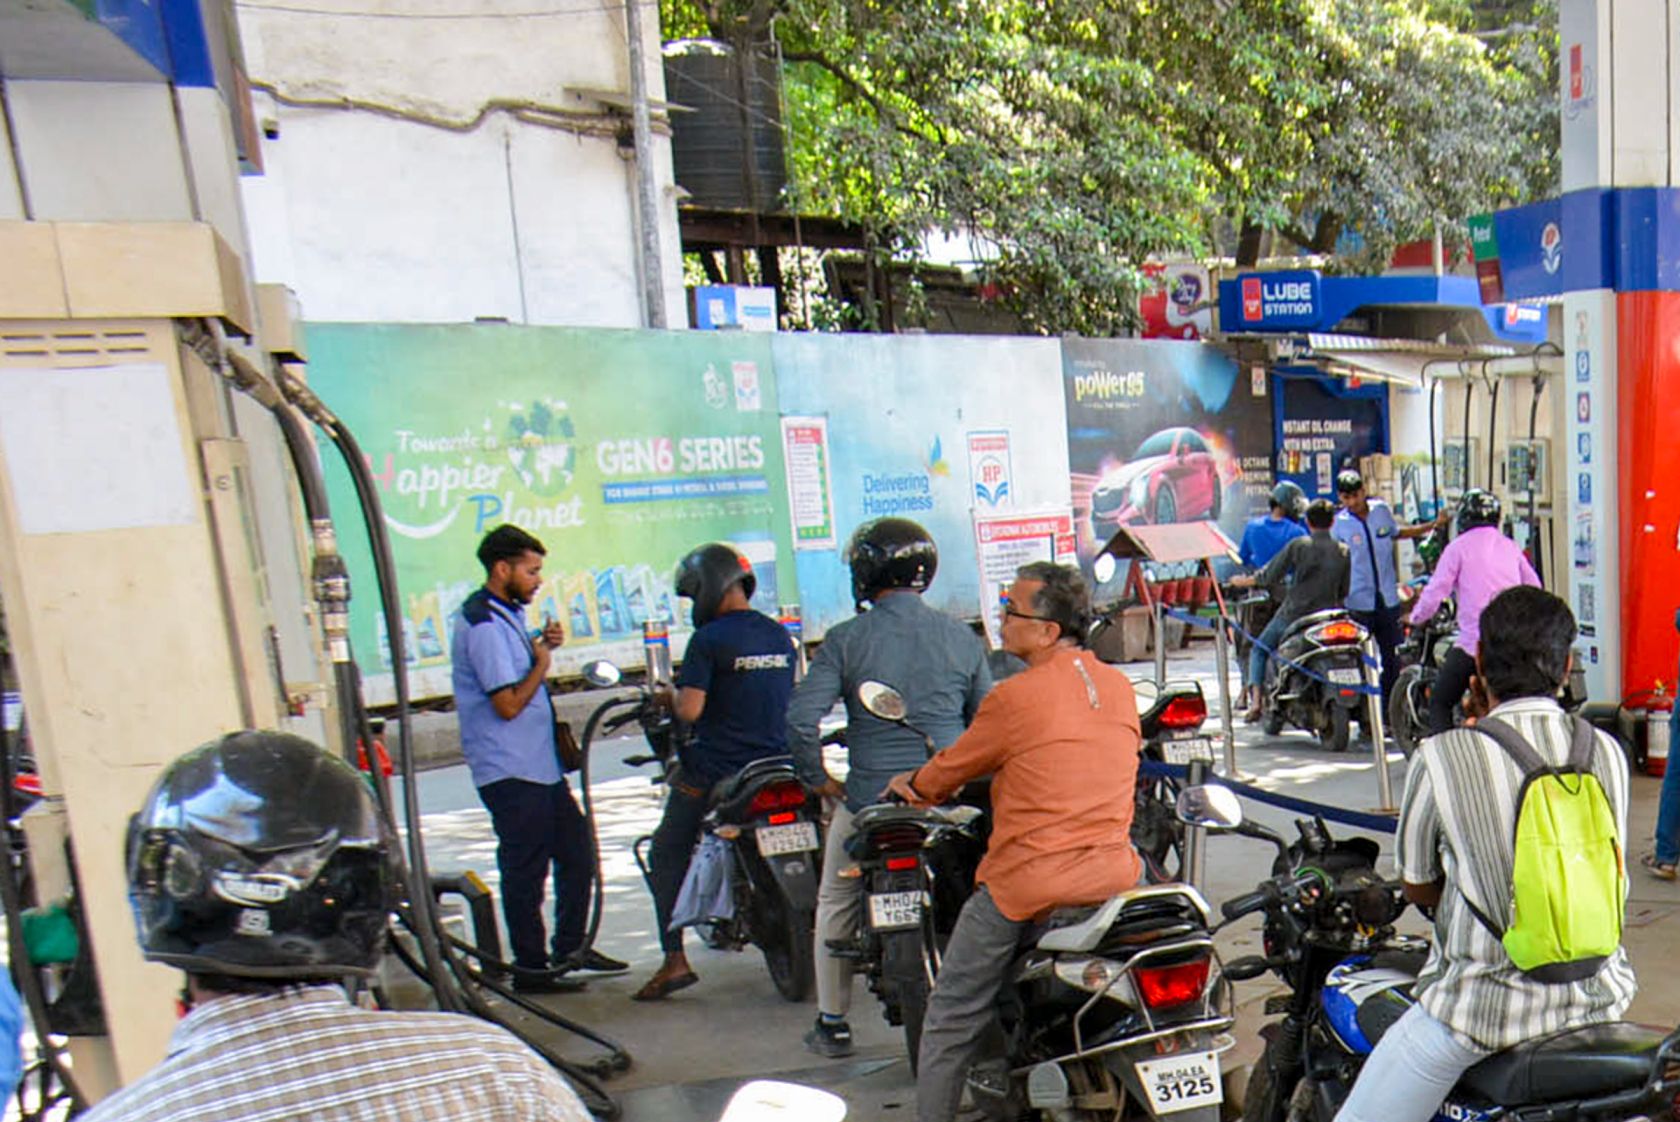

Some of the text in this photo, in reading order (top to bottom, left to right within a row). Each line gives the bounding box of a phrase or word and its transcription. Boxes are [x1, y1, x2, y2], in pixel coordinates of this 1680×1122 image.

[1263, 282, 1311, 301] LUBE
[1264, 302, 1312, 316] STATION
[1324, 420, 1352, 432] CHANGE
[394, 427, 478, 453] Towards
[1313, 438, 1335, 449] EXTRA
[597, 435, 765, 476] GEN6 SERIES
[362, 452, 506, 509] Happier
[863, 473, 930, 494] Delivering
[983, 466, 1001, 483] HP
[466, 490, 585, 534] Planet
[863, 495, 933, 516] Happiness
[1156, 1076, 1214, 1102] 3125
